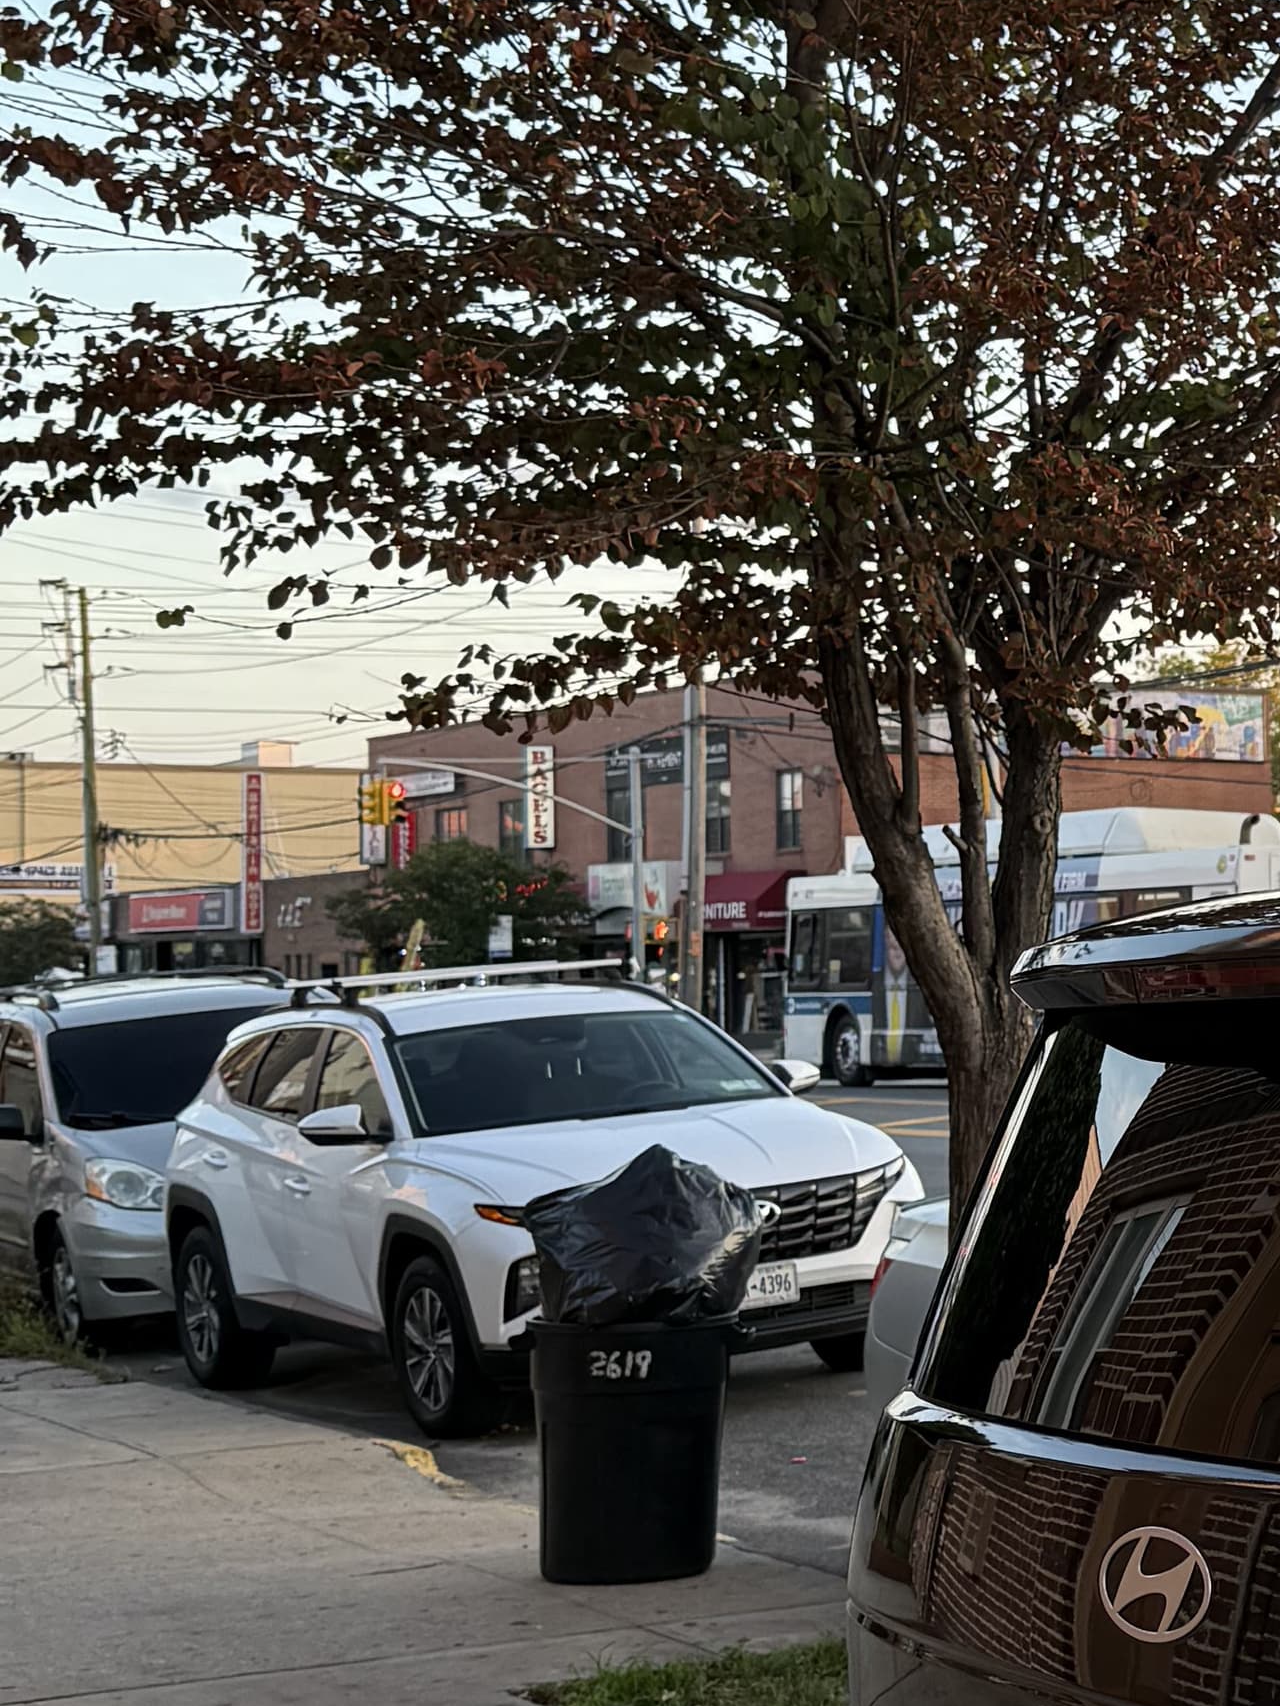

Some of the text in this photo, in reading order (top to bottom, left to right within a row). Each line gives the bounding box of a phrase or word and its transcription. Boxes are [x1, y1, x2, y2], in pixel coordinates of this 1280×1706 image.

[531, 751, 548, 844] BAGELS
[704, 901, 746, 920] NITURE
[588, 1349, 653, 1380] 2619
